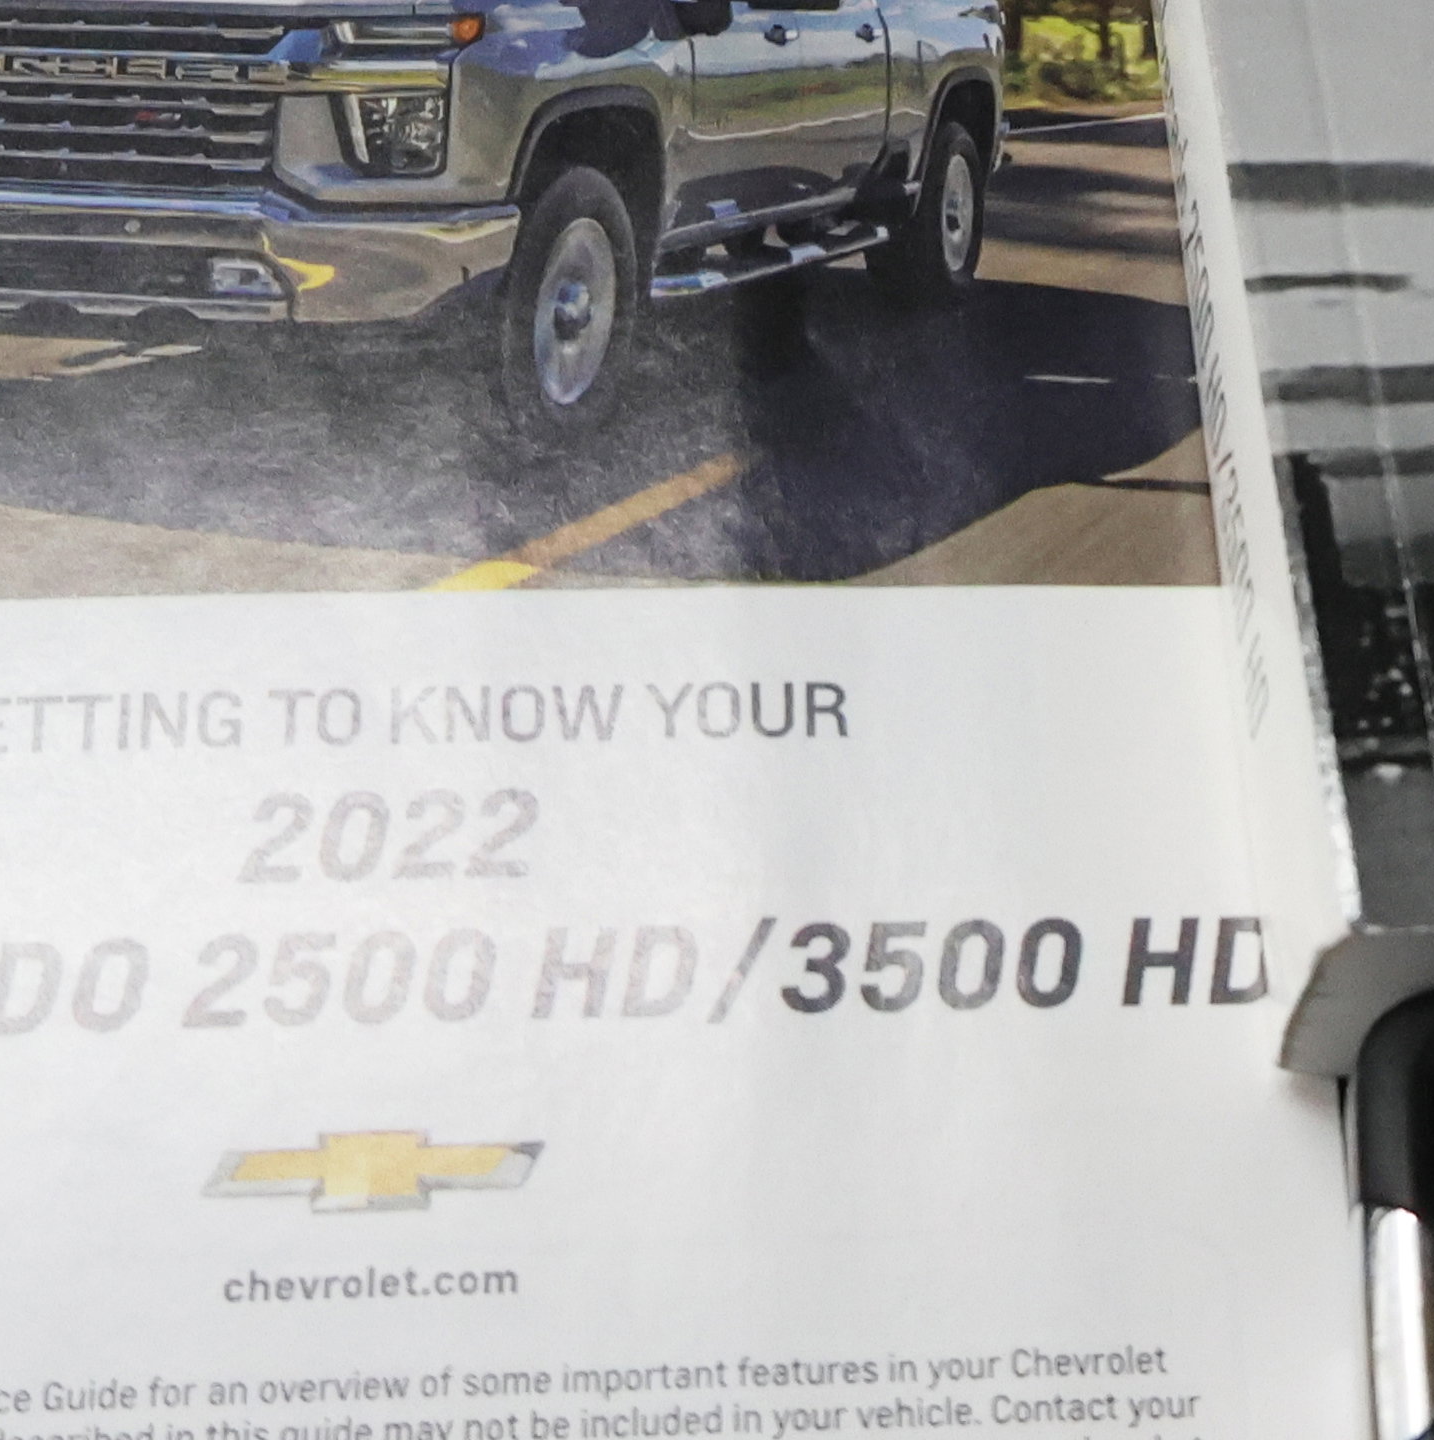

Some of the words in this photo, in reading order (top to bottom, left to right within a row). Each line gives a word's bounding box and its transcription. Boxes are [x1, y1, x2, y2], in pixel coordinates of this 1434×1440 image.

[269, 688, 364, 747] TO
[388, 683, 623, 746] KNOW
[645, 680, 850, 741] YOUR
[237, 786, 542, 885] 2022
[182, 925, 496, 1029] 2500
[531, 916, 1084, 1023] HD/3500
[1121, 916, 1270, 1007] HD
[223, 1264, 520, 1303] chevrolet.com
[42, 1378, 138, 1413] Guide
[148, 1375, 197, 1408] for
[207, 1380, 248, 1407] an
[258, 1371, 410, 1405] overview
[419, 1365, 453, 1399] of
[462, 1371, 552, 1398] some
[562, 1360, 728, 1401] important
[737, 1356, 879, 1388] features
[887, 1354, 918, 1383] in
[927, 1356, 1002, 1391] your
[1010, 1344, 1168, 1379] Chevrolet
[530, 1409, 571, 1440] be
[580, 1403, 723, 1439] included
[732, 1403, 763, 1433] in
[772, 1406, 848, 1440] your
[855, 1396, 982, 1430] vehicle.
[990, 1393, 1119, 1426] Contact
[1127, 1395, 1201, 1429] your
